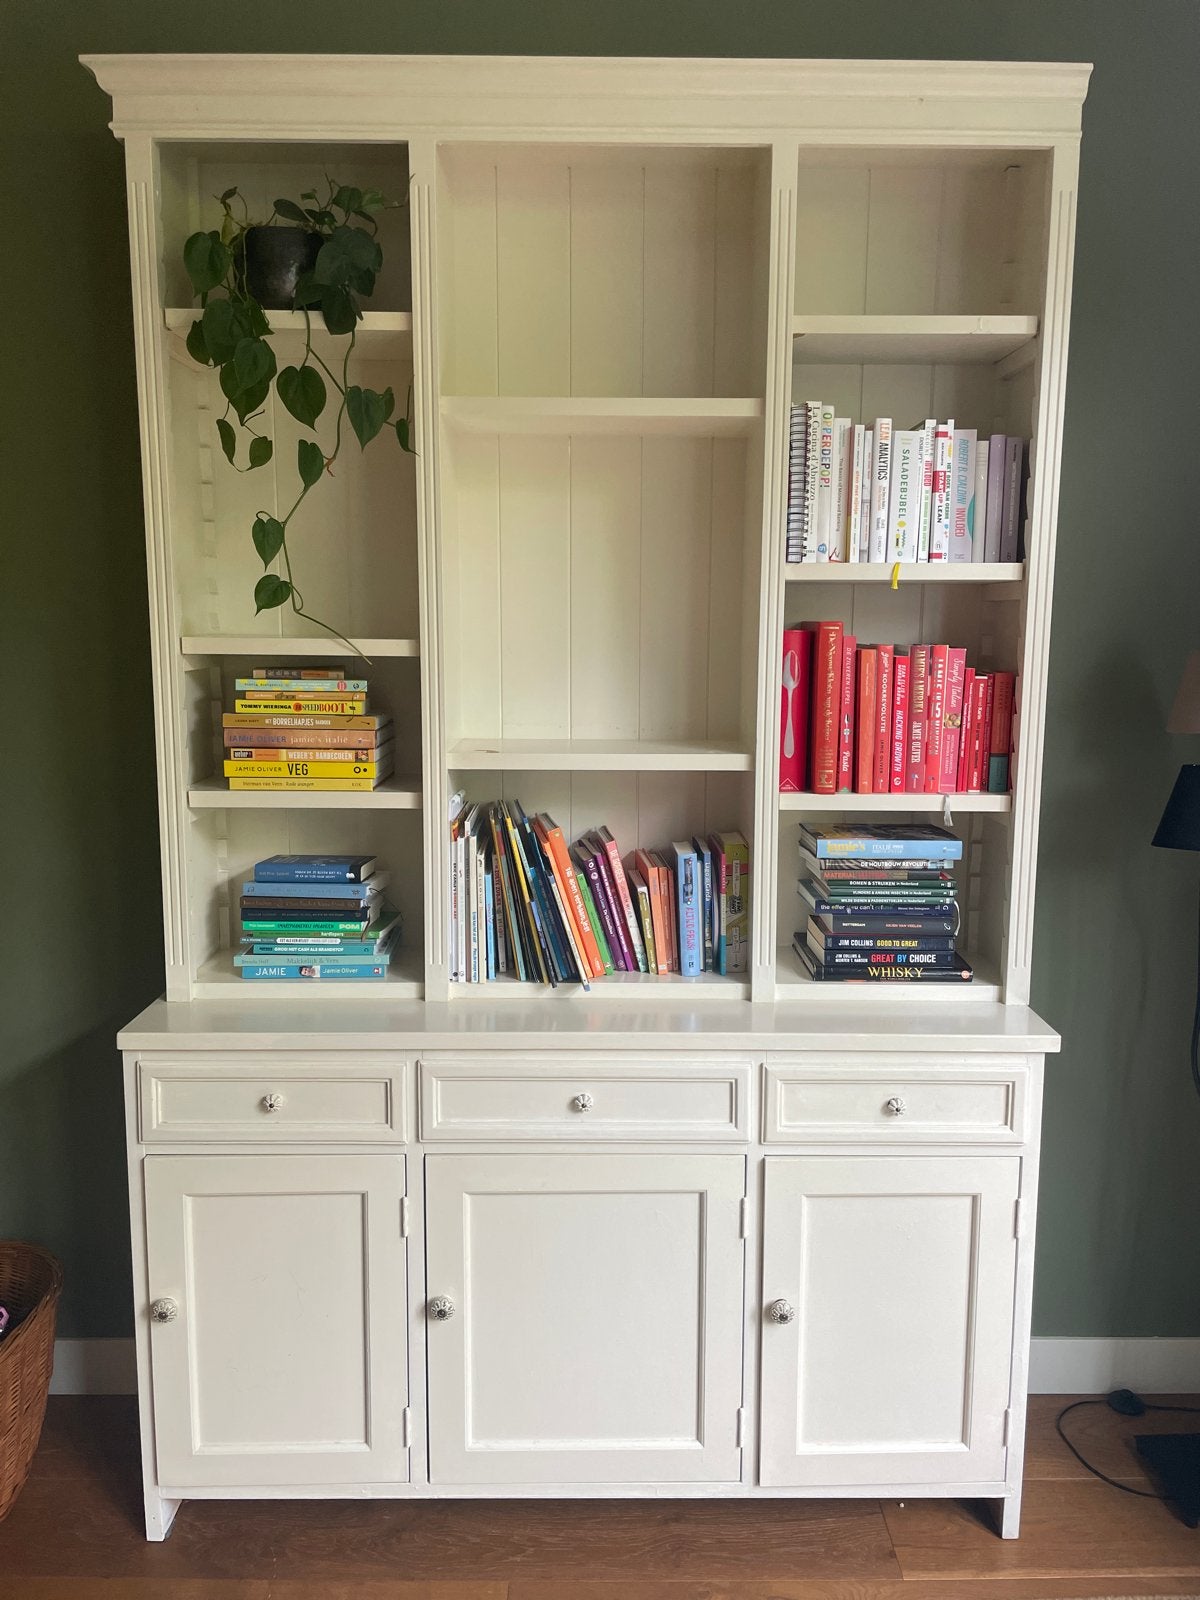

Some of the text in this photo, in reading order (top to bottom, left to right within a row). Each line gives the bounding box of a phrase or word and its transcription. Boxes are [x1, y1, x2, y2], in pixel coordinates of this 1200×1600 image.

[811, 420, 819, 450] Cucina
[878, 423, 890, 441] LEAN
[820, 412, 832, 488] OPPERDEPOP!
[959, 438, 970, 465] ROBERT
[878, 442, 889, 480] ANALYTICS
[956, 475, 967, 505] CIALDINI
[955, 507, 965, 537] INVLOED
[948, 658, 964, 708] Simply Italian
[880, 673, 888, 733] KOOKREVOLUTIE
[272, 717, 314, 727] BORRELHAPJES
[912, 721, 922, 740] JAMIE
[256, 735, 287, 743] OLIVER
[290, 735, 322, 745] jamie's
[893, 709, 904, 772] HACKING GROWTH
[842, 750, 851, 771] Pasta
[911, 741, 921, 763] OLIVER
[287, 763, 309, 776] VEG
[838, 939, 850, 947] JIM
[850, 939, 874, 947] COLLINS
[876, 939, 892, 947] GOOD
[871, 954, 936, 963] GREAT BY CHOICE
[255, 967, 287, 976] JAMIE
[867, 966, 924, 978] WHISKY
